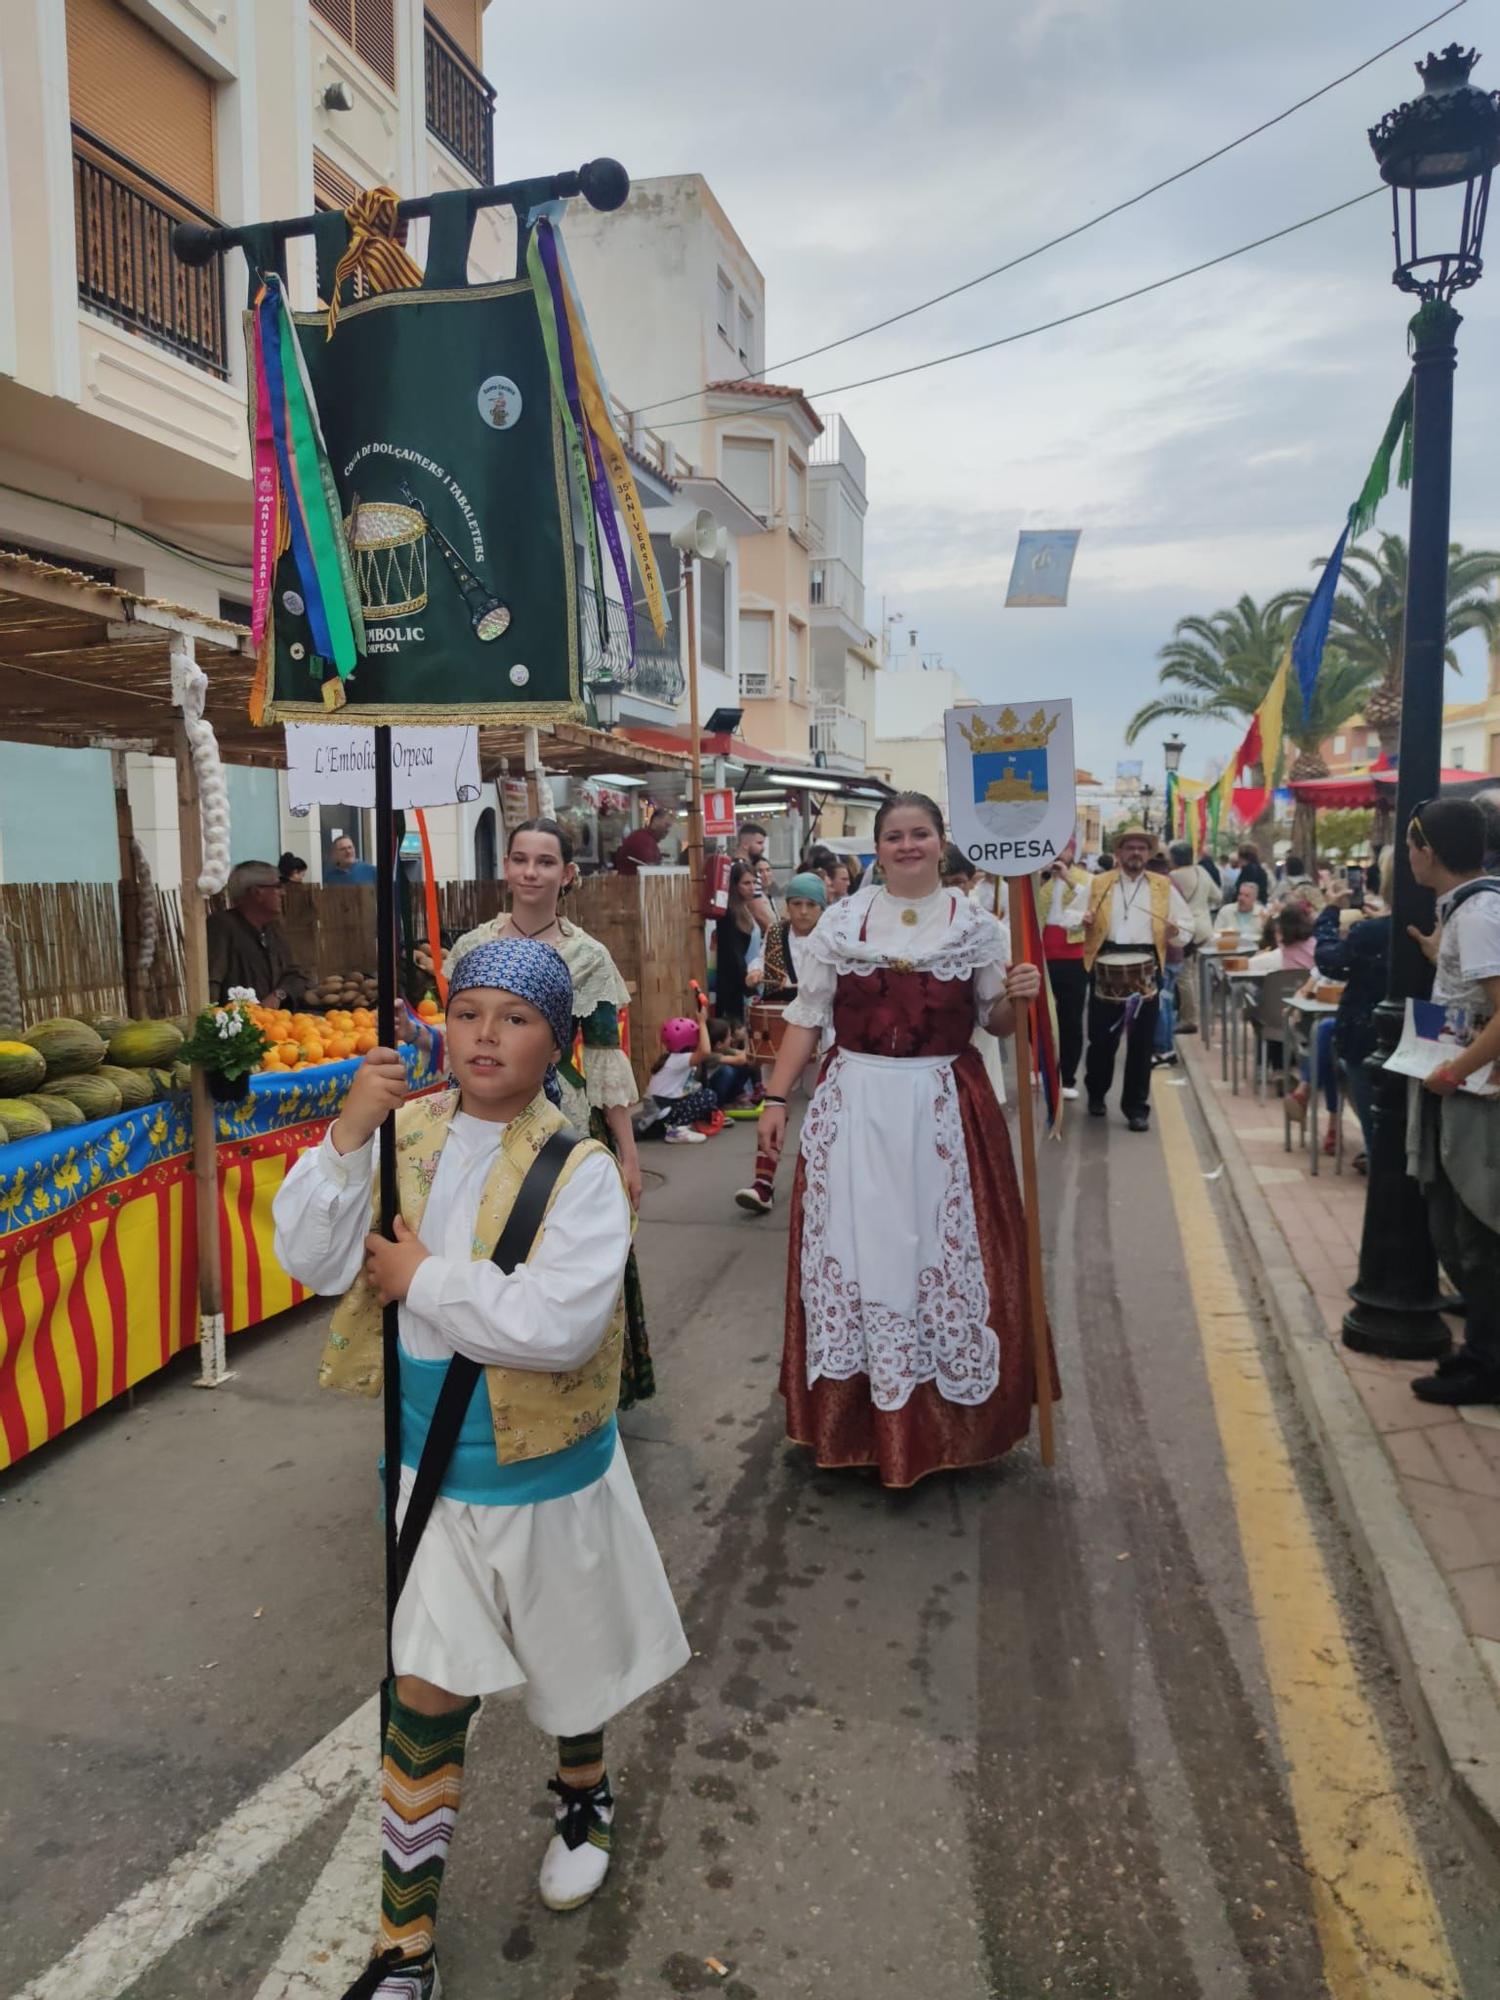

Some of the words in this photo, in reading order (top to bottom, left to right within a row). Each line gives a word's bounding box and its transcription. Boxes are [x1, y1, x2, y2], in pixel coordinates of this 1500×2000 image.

[259, 503, 269, 588] ANIVERSARI
[373, 443, 445, 478] DOLÇAINERS
[443, 475, 452, 484] I
[449, 481, 485, 563] TABALETERS
[624, 493, 654, 591] ANIVERSARI
[366, 627, 425, 642] MBOLIC
[968, 839, 1056, 861] ORPESA
